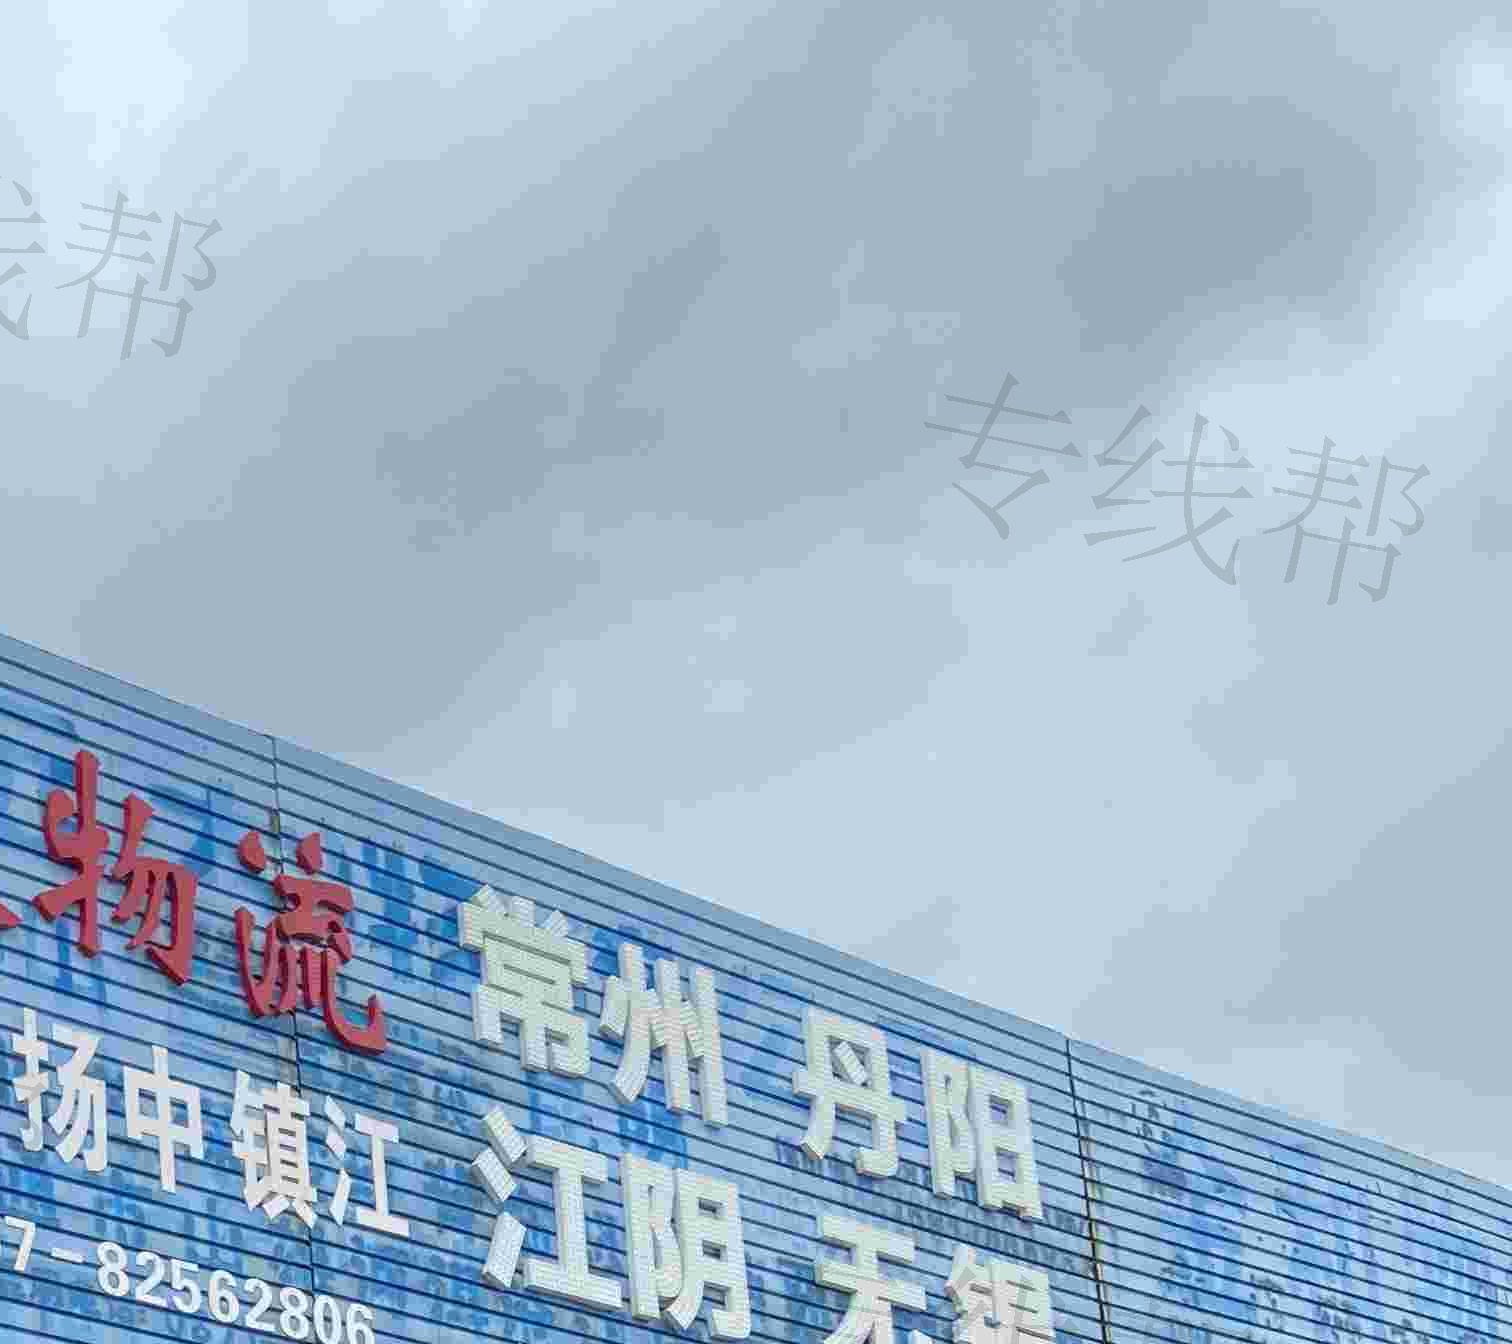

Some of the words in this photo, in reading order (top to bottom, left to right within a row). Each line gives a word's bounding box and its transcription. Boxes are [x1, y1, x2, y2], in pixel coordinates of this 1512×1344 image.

[11, 1008, 203, 1193] 扬中
[229, 1069, 410, 1237] 镇江
[457, 885, 728, 1127] 常州
[791, 1006, 1043, 1220] 丹阳
[471, 1105, 751, 1342] 江阴
